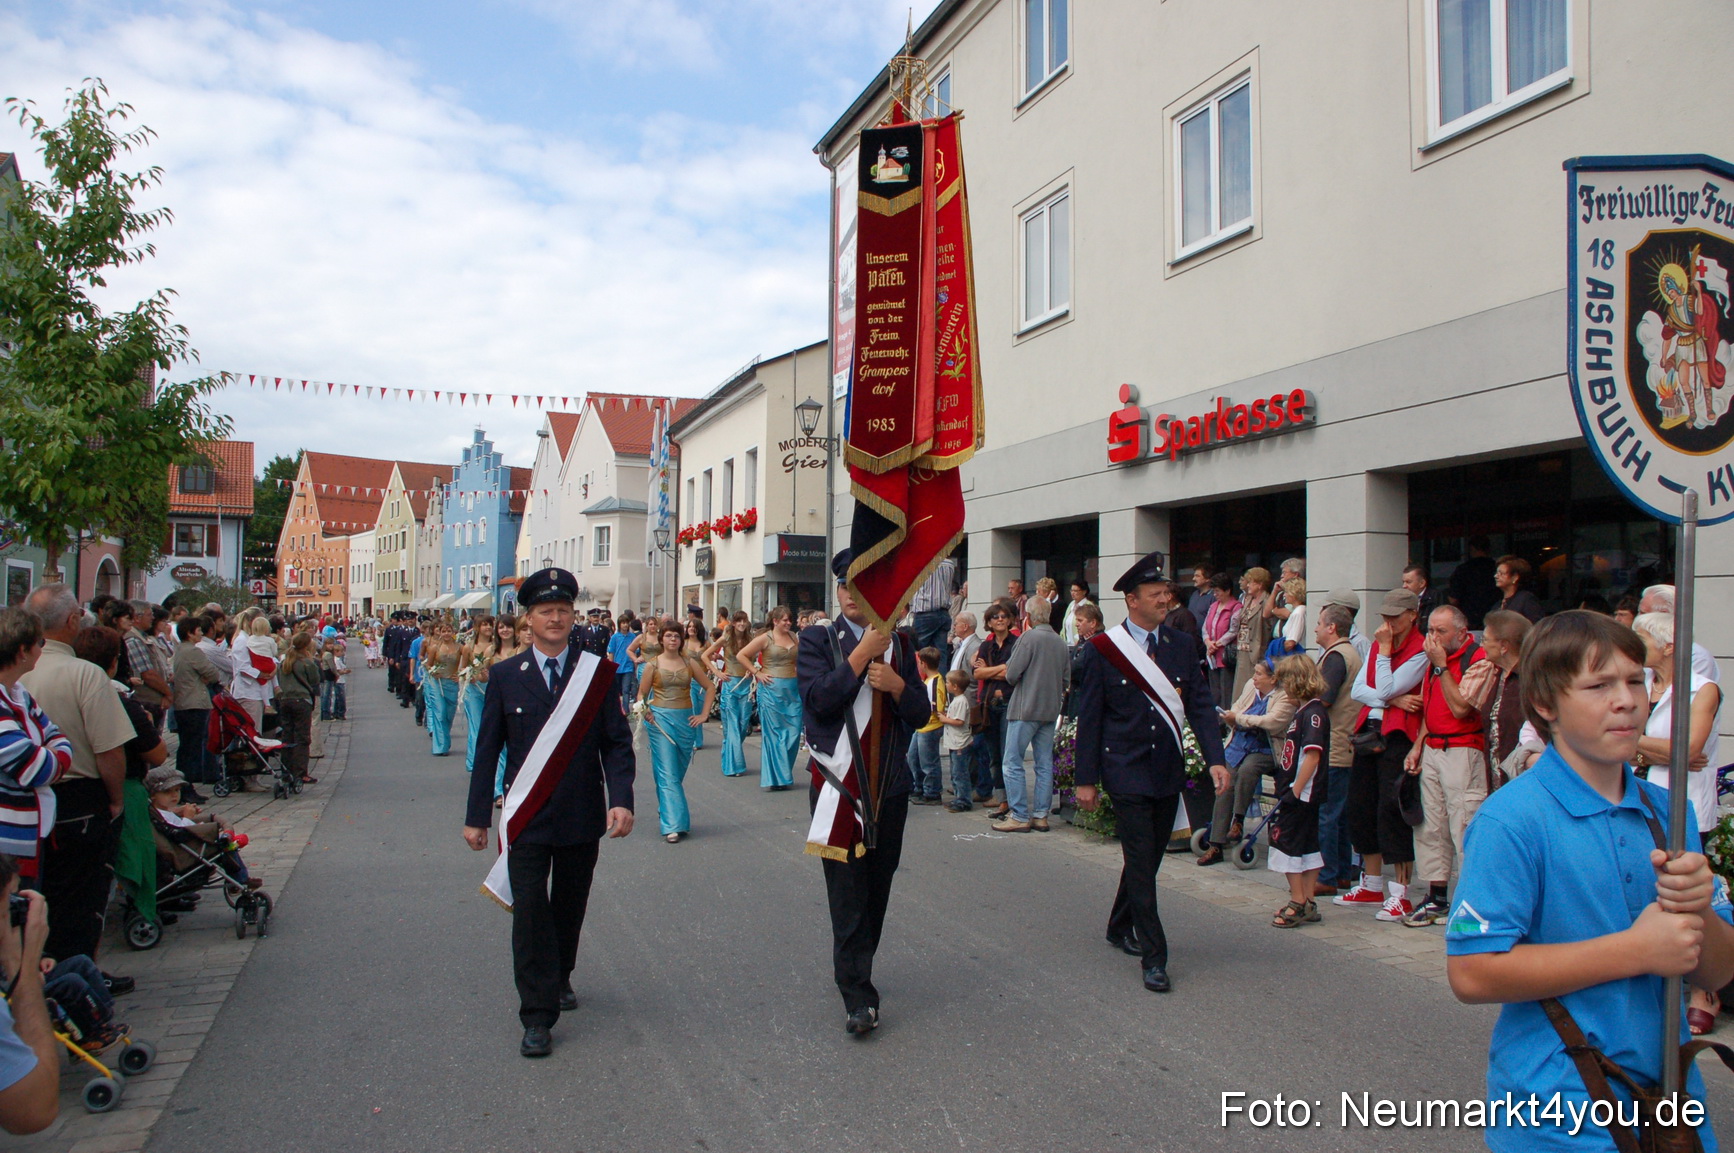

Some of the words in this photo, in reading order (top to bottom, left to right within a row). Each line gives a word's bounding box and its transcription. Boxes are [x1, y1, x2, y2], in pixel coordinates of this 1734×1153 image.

[1578, 184, 1699, 225] Freiwillige
[865, 252, 909, 265] Unserem
[937, 253, 955, 266] eihe
[1587, 238, 1615, 271] 18
[867, 268, 906, 292] Paten
[866, 298, 906, 314] gewidmet
[867, 317, 885, 325] von
[887, 313, 904, 324] der
[860, 346, 910, 363] Feuerwehr
[1585, 276, 1652, 483] ASCHBUCH
[872, 382, 896, 398] dorf
[866, 417, 896, 432] 1983
[1153, 388, 1308, 462] Sparkasse
[782, 453, 828, 474] Gier
[782, 549, 800, 557] Mode
[809, 549, 827, 557] Männ
